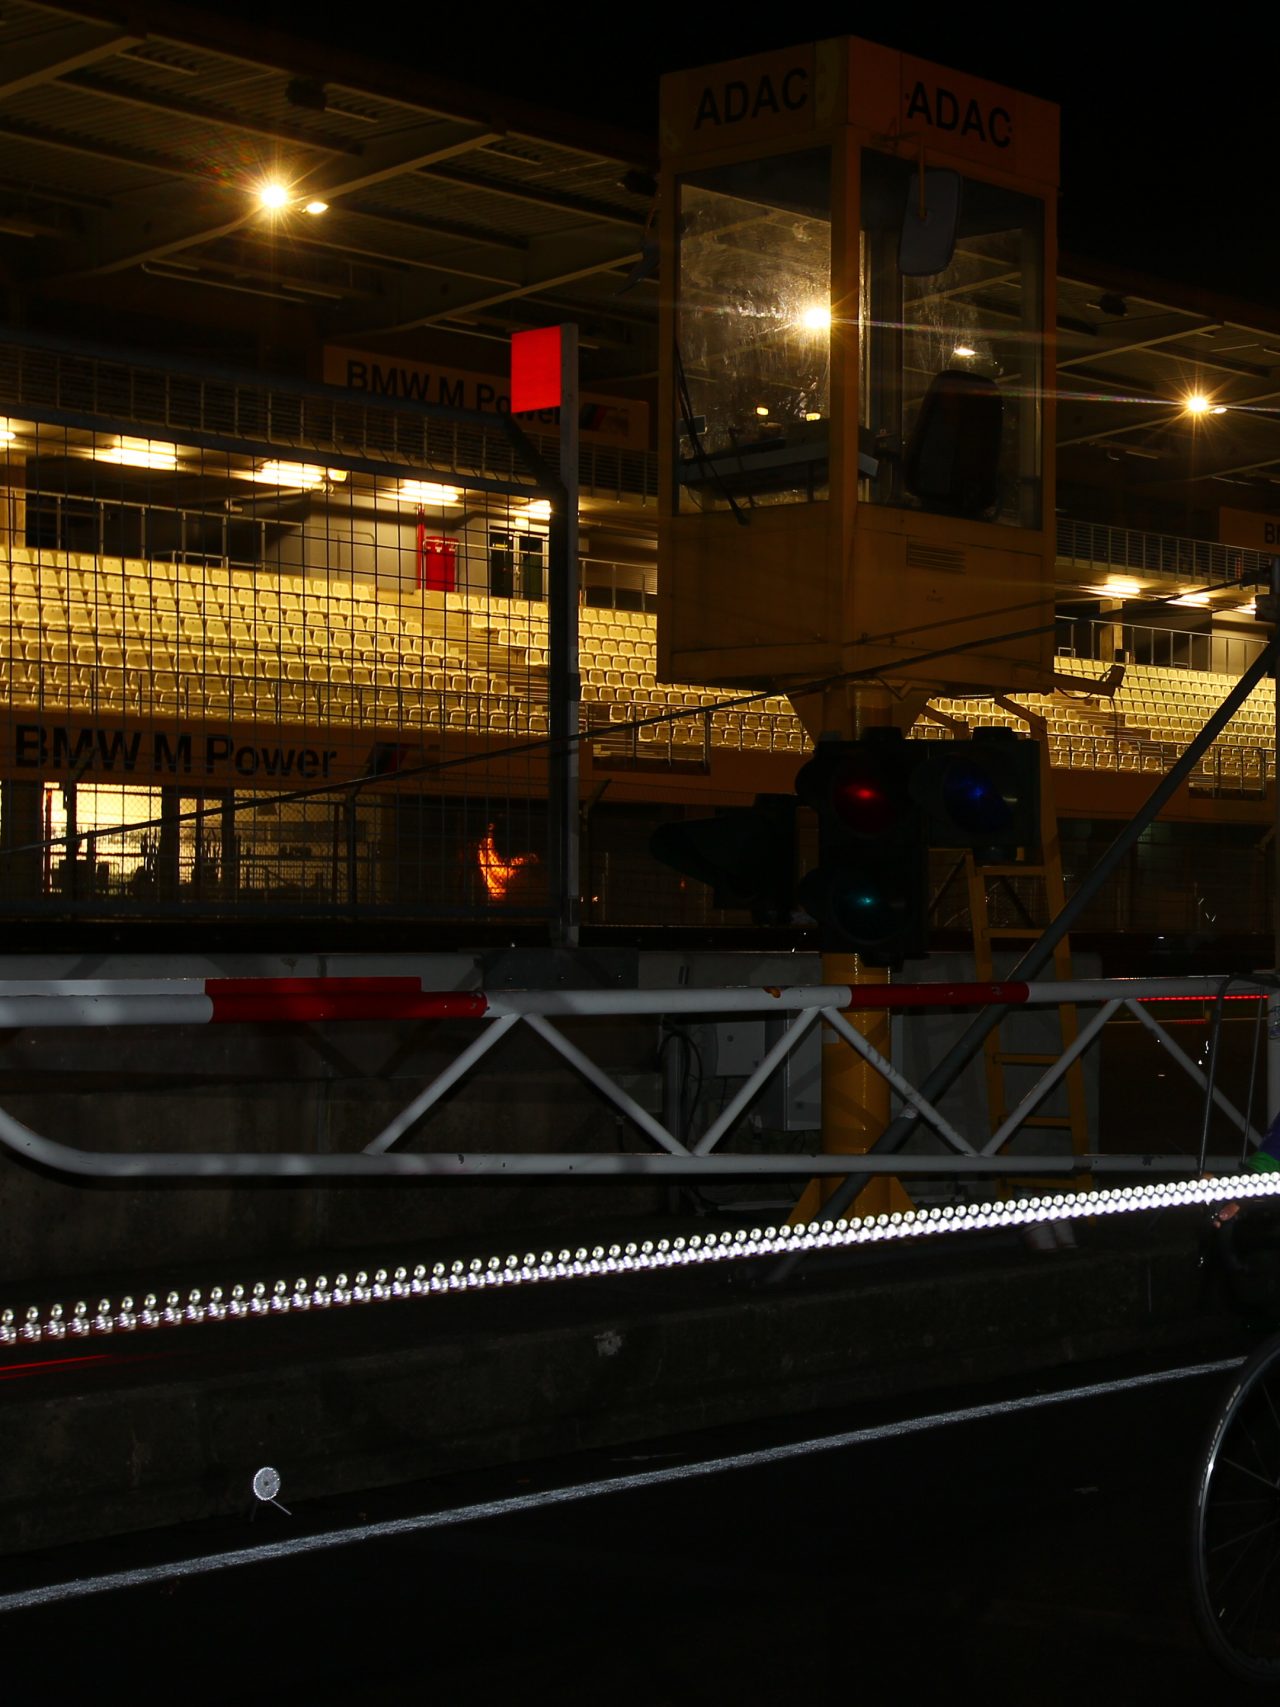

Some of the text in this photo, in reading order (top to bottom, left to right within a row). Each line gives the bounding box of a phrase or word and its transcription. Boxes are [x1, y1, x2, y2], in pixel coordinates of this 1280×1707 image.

[694, 68, 808, 130] ADAC
[906, 81, 1010, 147] ADAC
[347, 358, 429, 402] BMW
[438, 376, 464, 409] M
[15, 724, 337, 778] BMW M Power
